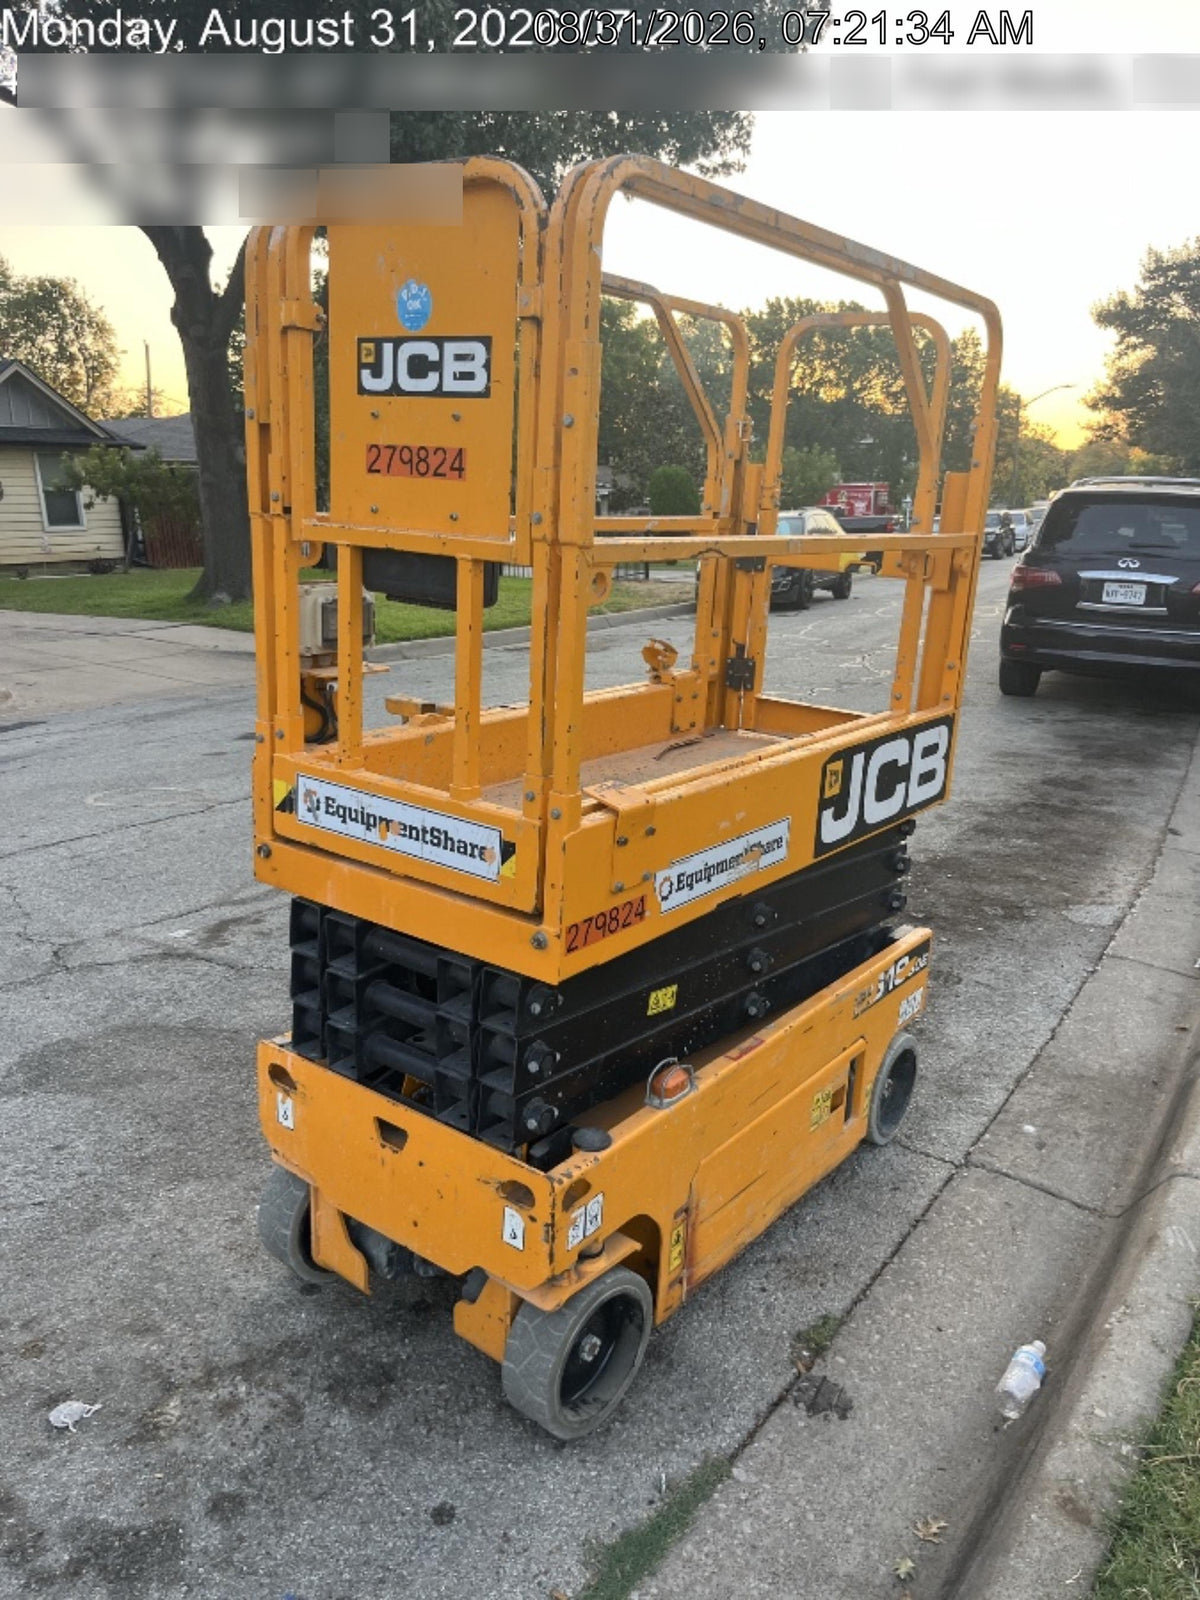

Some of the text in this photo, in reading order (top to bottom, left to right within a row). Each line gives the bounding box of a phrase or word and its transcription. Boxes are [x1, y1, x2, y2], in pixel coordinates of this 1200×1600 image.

[360, 341, 488, 392] JCB
[367, 444, 465, 479] 279824
[821, 725, 949, 844] JCB
[566, 896, 647, 953] 279824
